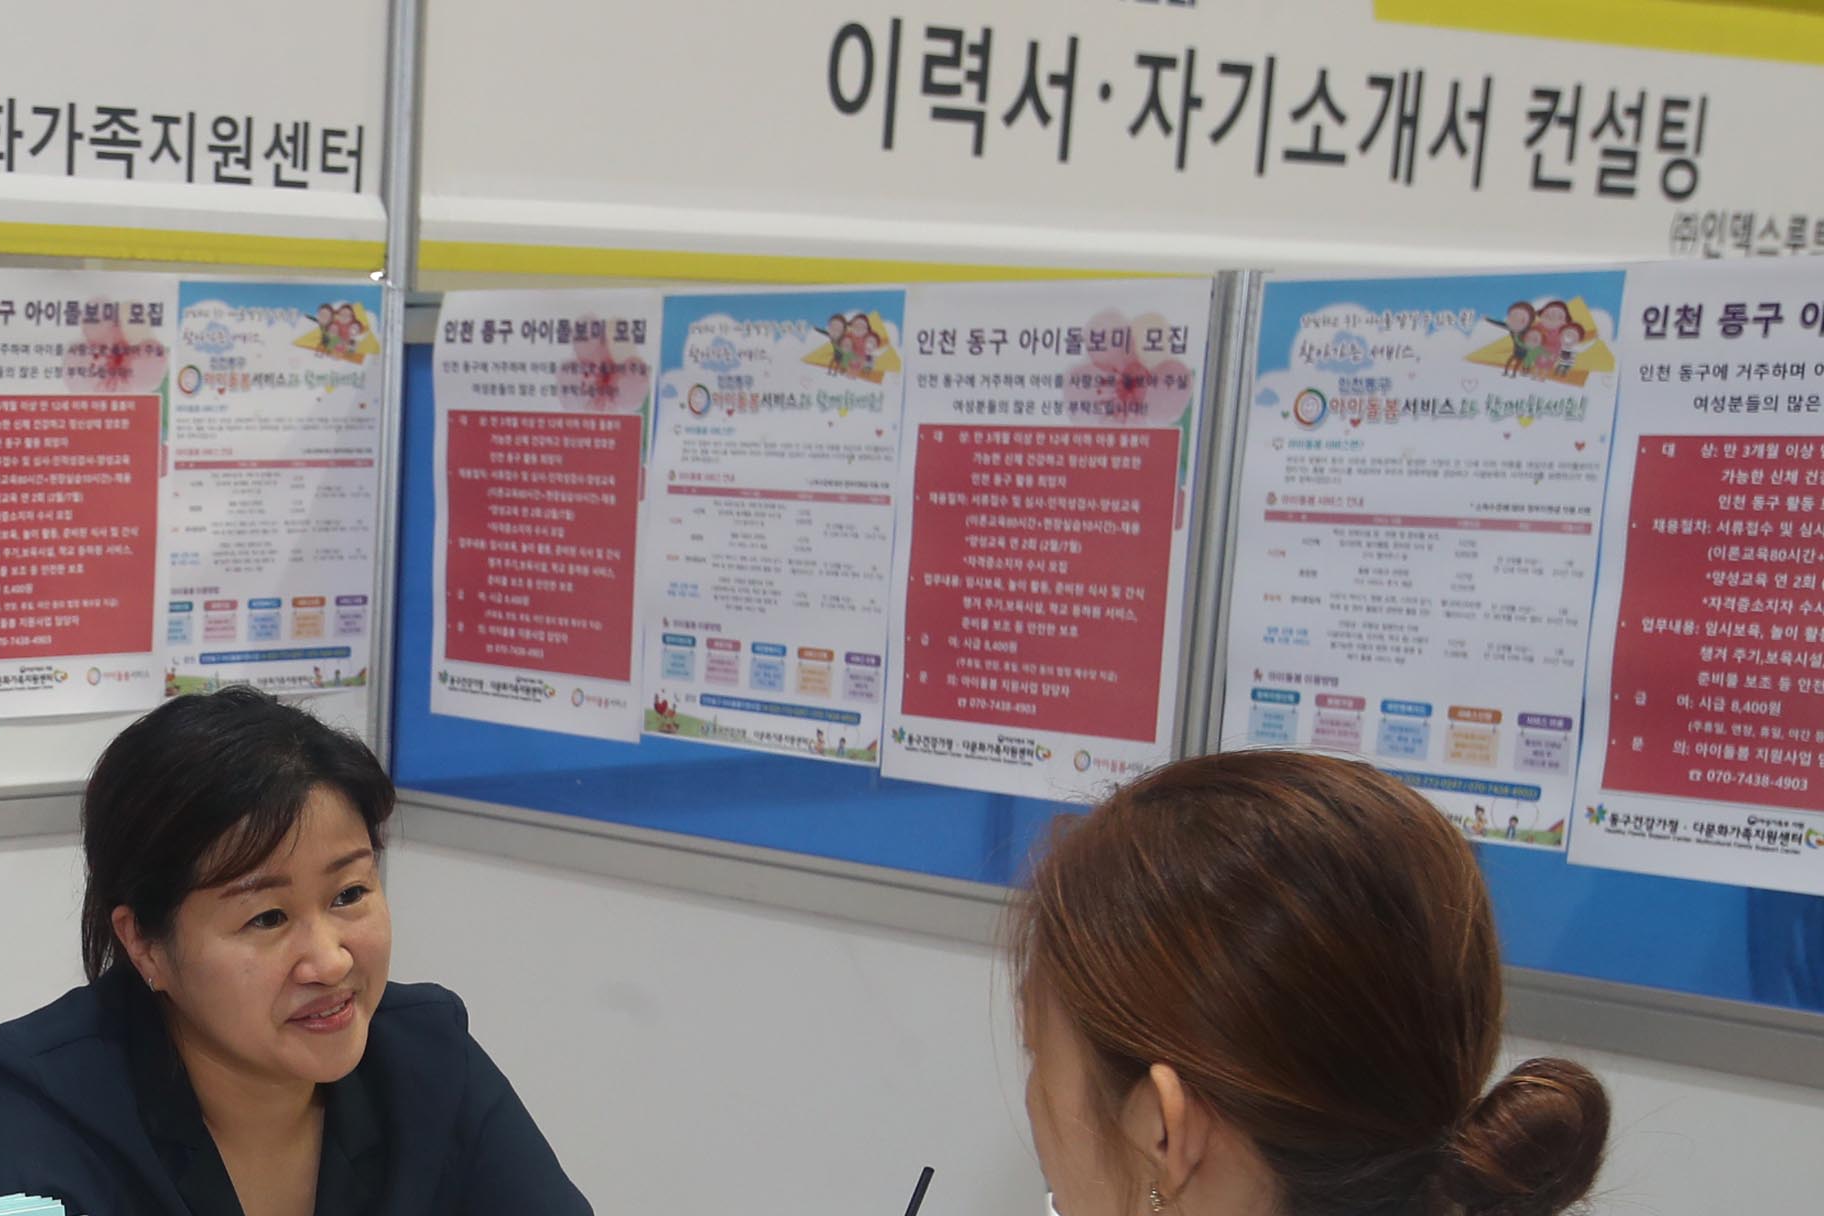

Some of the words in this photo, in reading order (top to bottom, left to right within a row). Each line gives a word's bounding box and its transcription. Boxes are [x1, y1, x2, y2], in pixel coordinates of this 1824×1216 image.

[827, 17, 1494, 190] 이력서·자기소개서
[1524, 83, 1709, 202] 컨설팅
[23, 299, 119, 327] 아이돌보미
[127, 302, 164, 327] 모집
[1643, 304, 1703, 340] 인천
[1718, 303, 1784, 339] 동구
[444, 319, 474, 344] 인천
[481, 319, 514, 344] 동구
[521, 319, 606, 344] 아이돌보미
[613, 319, 647, 344] 모집
[916, 327, 957, 356] 인천
[966, 327, 1009, 356] 동구
[1018, 325, 1132, 356] 아이돌보미
[1142, 325, 1189, 355] 모집
[1639, 363, 1671, 383] 인천
[1679, 363, 1729, 382] 동구에
[1736, 362, 1806, 381] 거주하며
[1694, 395, 1780, 413] 여성분들의
[1787, 395, 1821, 413] 많은
[1706, 769, 1809, 792] 070-7438-4903
